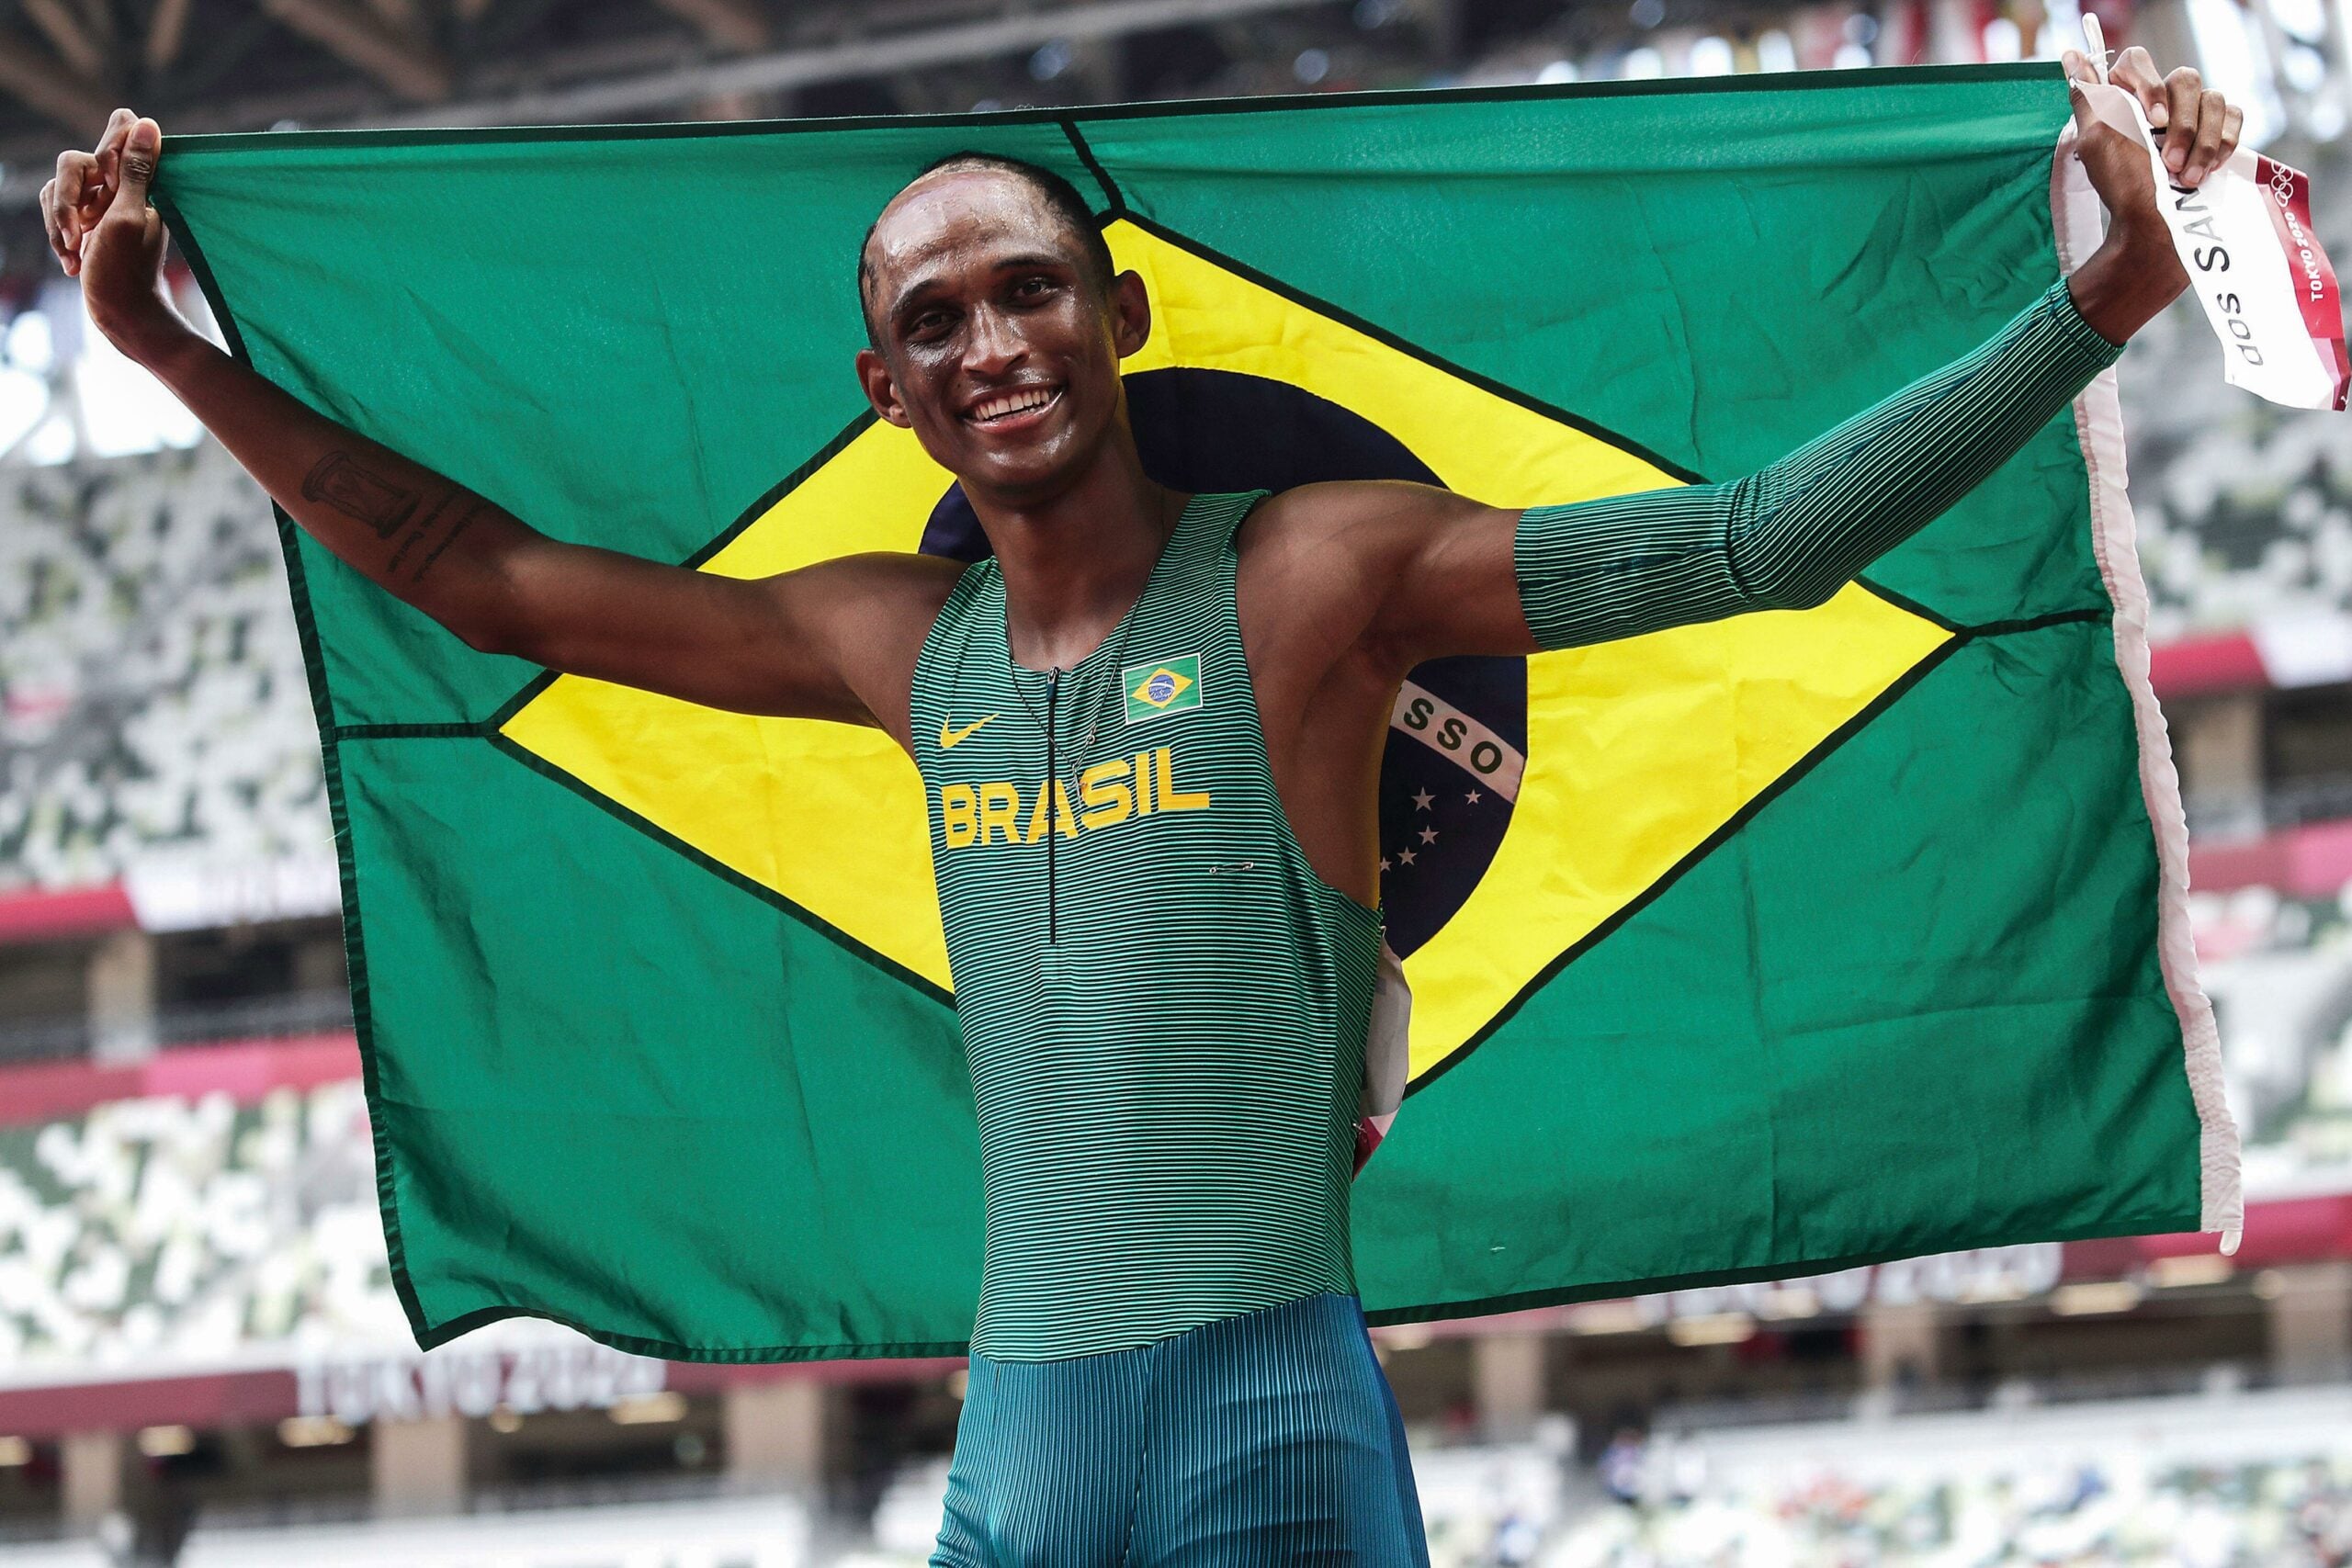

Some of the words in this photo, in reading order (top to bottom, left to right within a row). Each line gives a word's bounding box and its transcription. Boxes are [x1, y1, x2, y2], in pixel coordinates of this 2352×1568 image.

[2170, 185, 2232, 273] SAN
[2284, 211, 2310, 248] 2020
[2300, 249, 2324, 302] TOKYO
[2216, 292, 2265, 367] dos
[1402, 697, 1503, 774] SSO
[941, 747, 1211, 850] BRASIL
